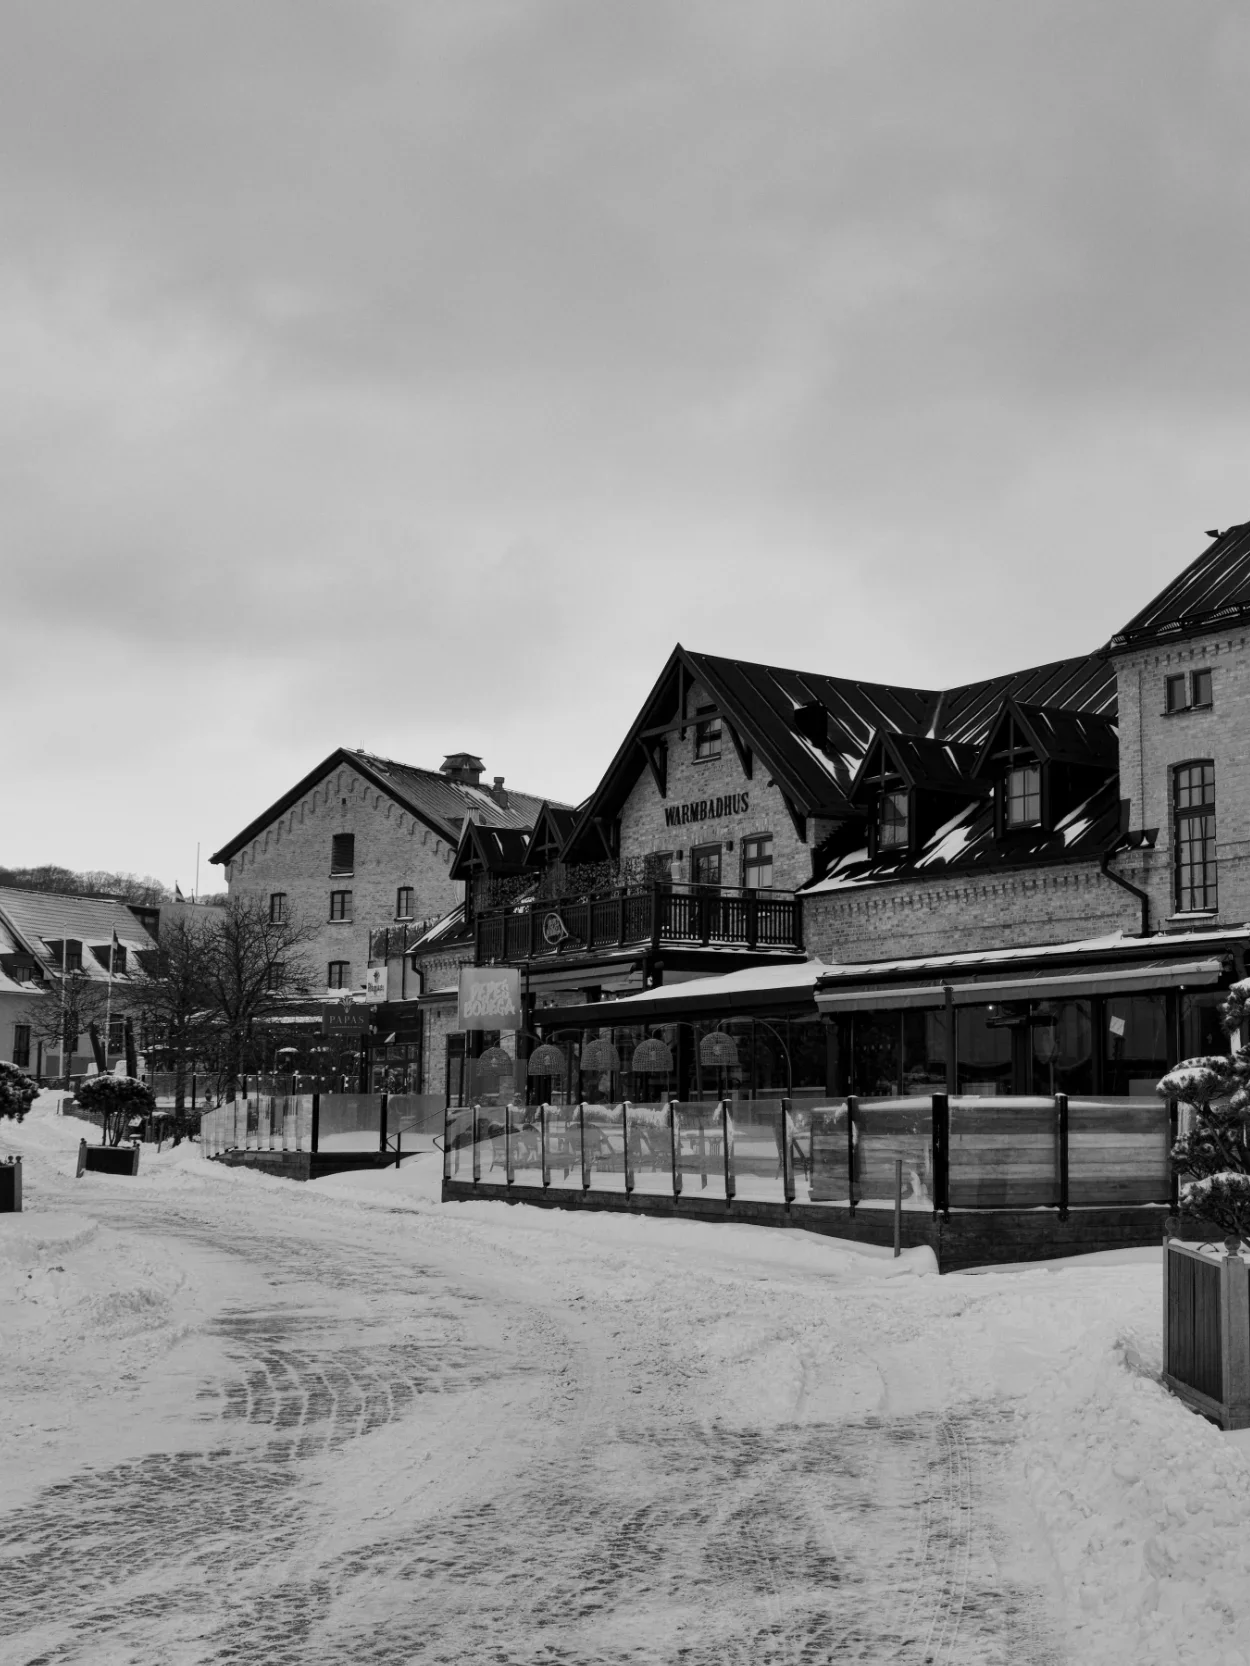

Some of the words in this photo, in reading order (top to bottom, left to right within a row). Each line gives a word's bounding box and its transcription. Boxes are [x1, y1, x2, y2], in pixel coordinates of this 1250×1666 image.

[664, 791, 749, 827] WARMBADHUS
[463, 998, 516, 1018] BODEGA
[329, 1015, 365, 1024] PAPAS
